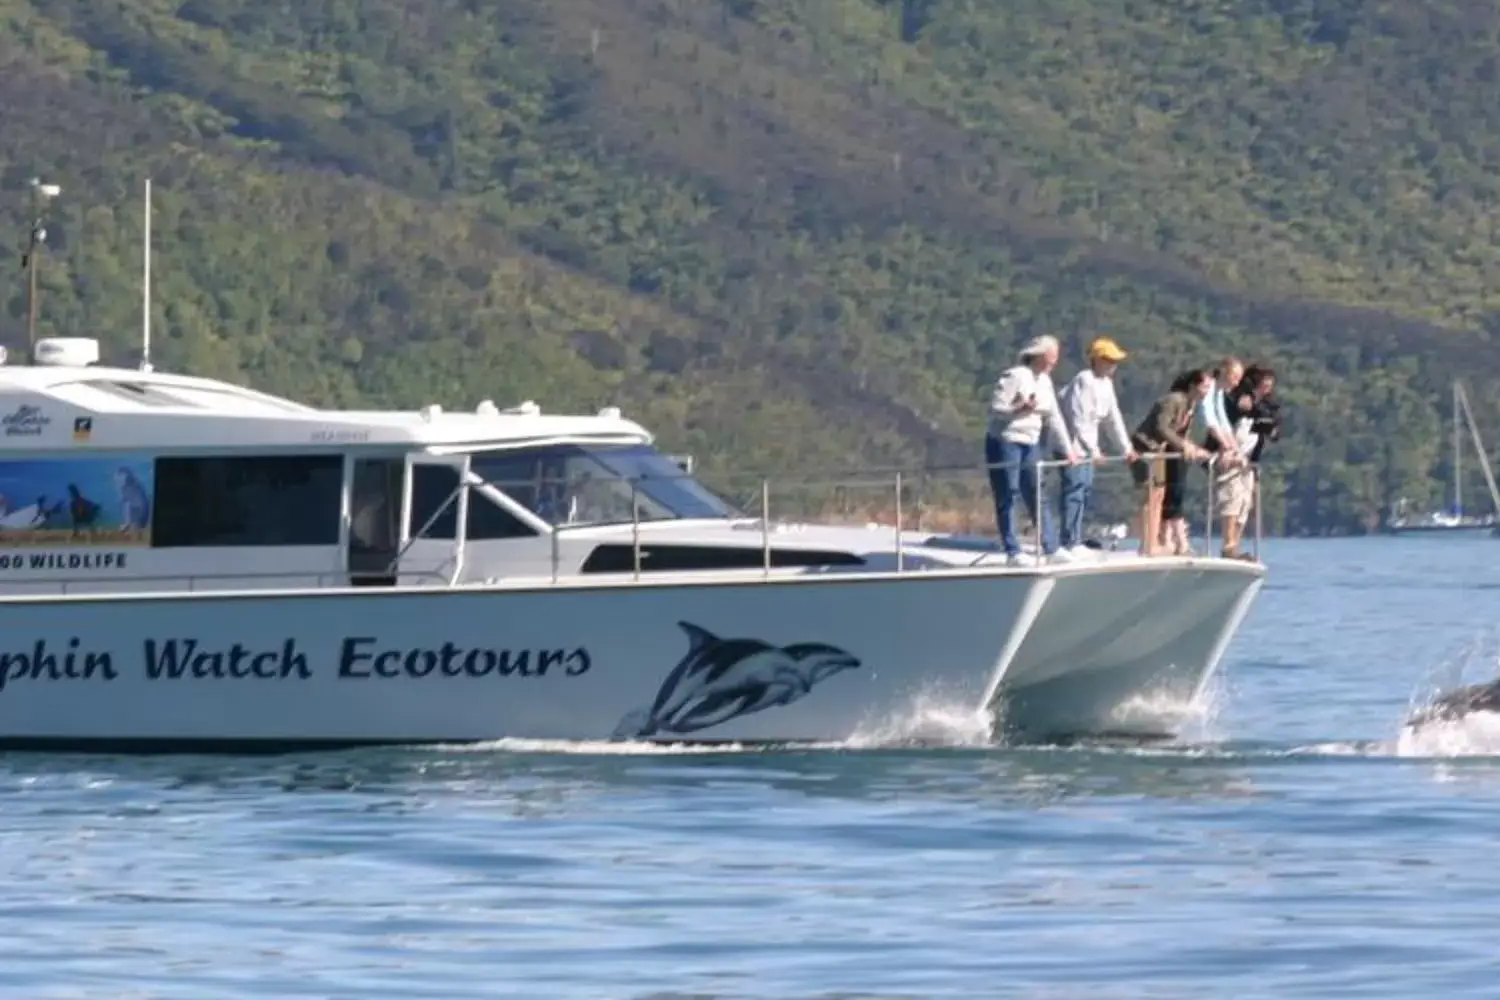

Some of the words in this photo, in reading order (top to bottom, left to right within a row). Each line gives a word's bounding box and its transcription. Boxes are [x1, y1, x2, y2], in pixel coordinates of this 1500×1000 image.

[30, 553, 127, 569] WILDLIFE
[0, 637, 119, 692] phin
[143, 637, 312, 680] Watch
[338, 636, 592, 680] Ecotours
